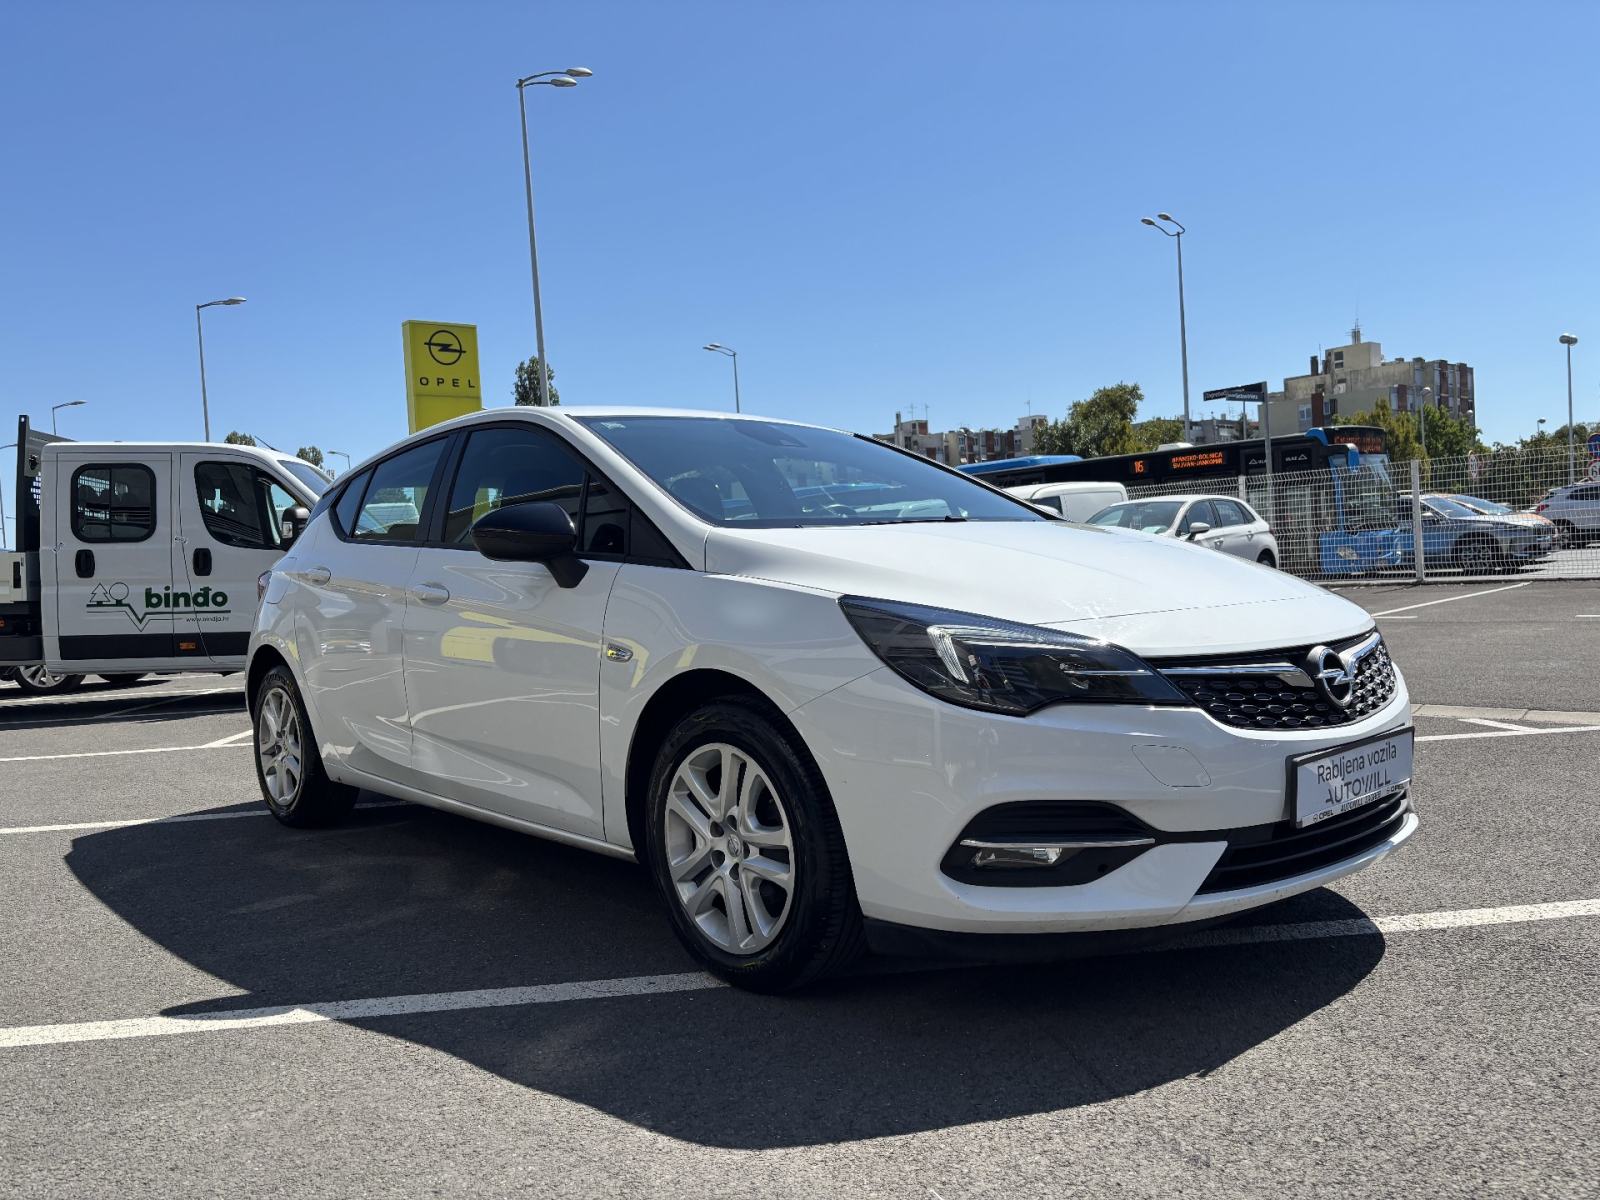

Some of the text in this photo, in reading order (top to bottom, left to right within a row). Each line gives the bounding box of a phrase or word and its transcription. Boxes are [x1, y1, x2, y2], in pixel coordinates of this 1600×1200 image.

[419, 377, 475, 388] OPEL
[1317, 742, 1397, 785] Rabljena vozila
[1318, 809, 1334, 820] OPEL
